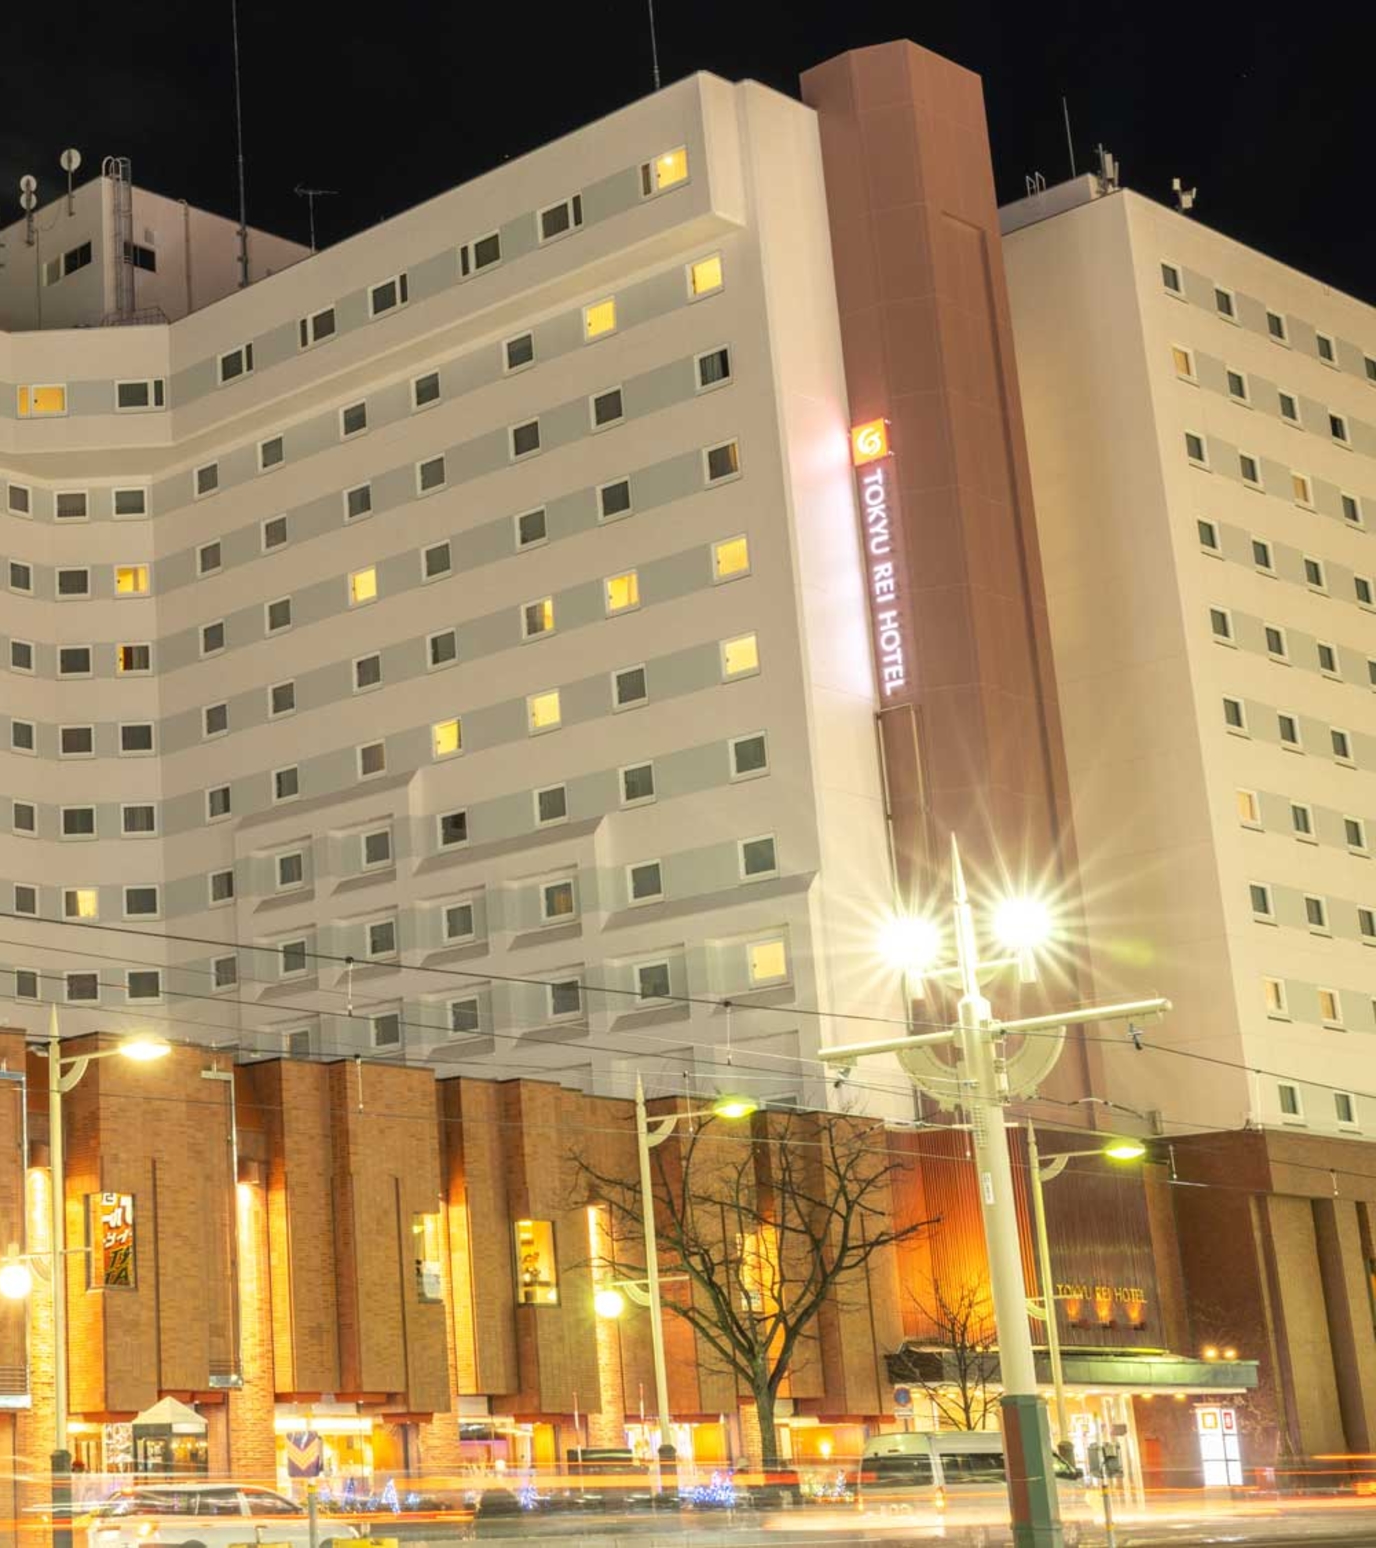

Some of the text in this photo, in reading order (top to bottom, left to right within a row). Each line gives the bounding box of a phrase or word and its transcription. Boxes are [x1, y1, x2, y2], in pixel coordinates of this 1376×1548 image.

[863, 467, 906, 697] TOKYU REI HOTEL
[1056, 1284, 1146, 1303] TOKYU REI HOTEL
